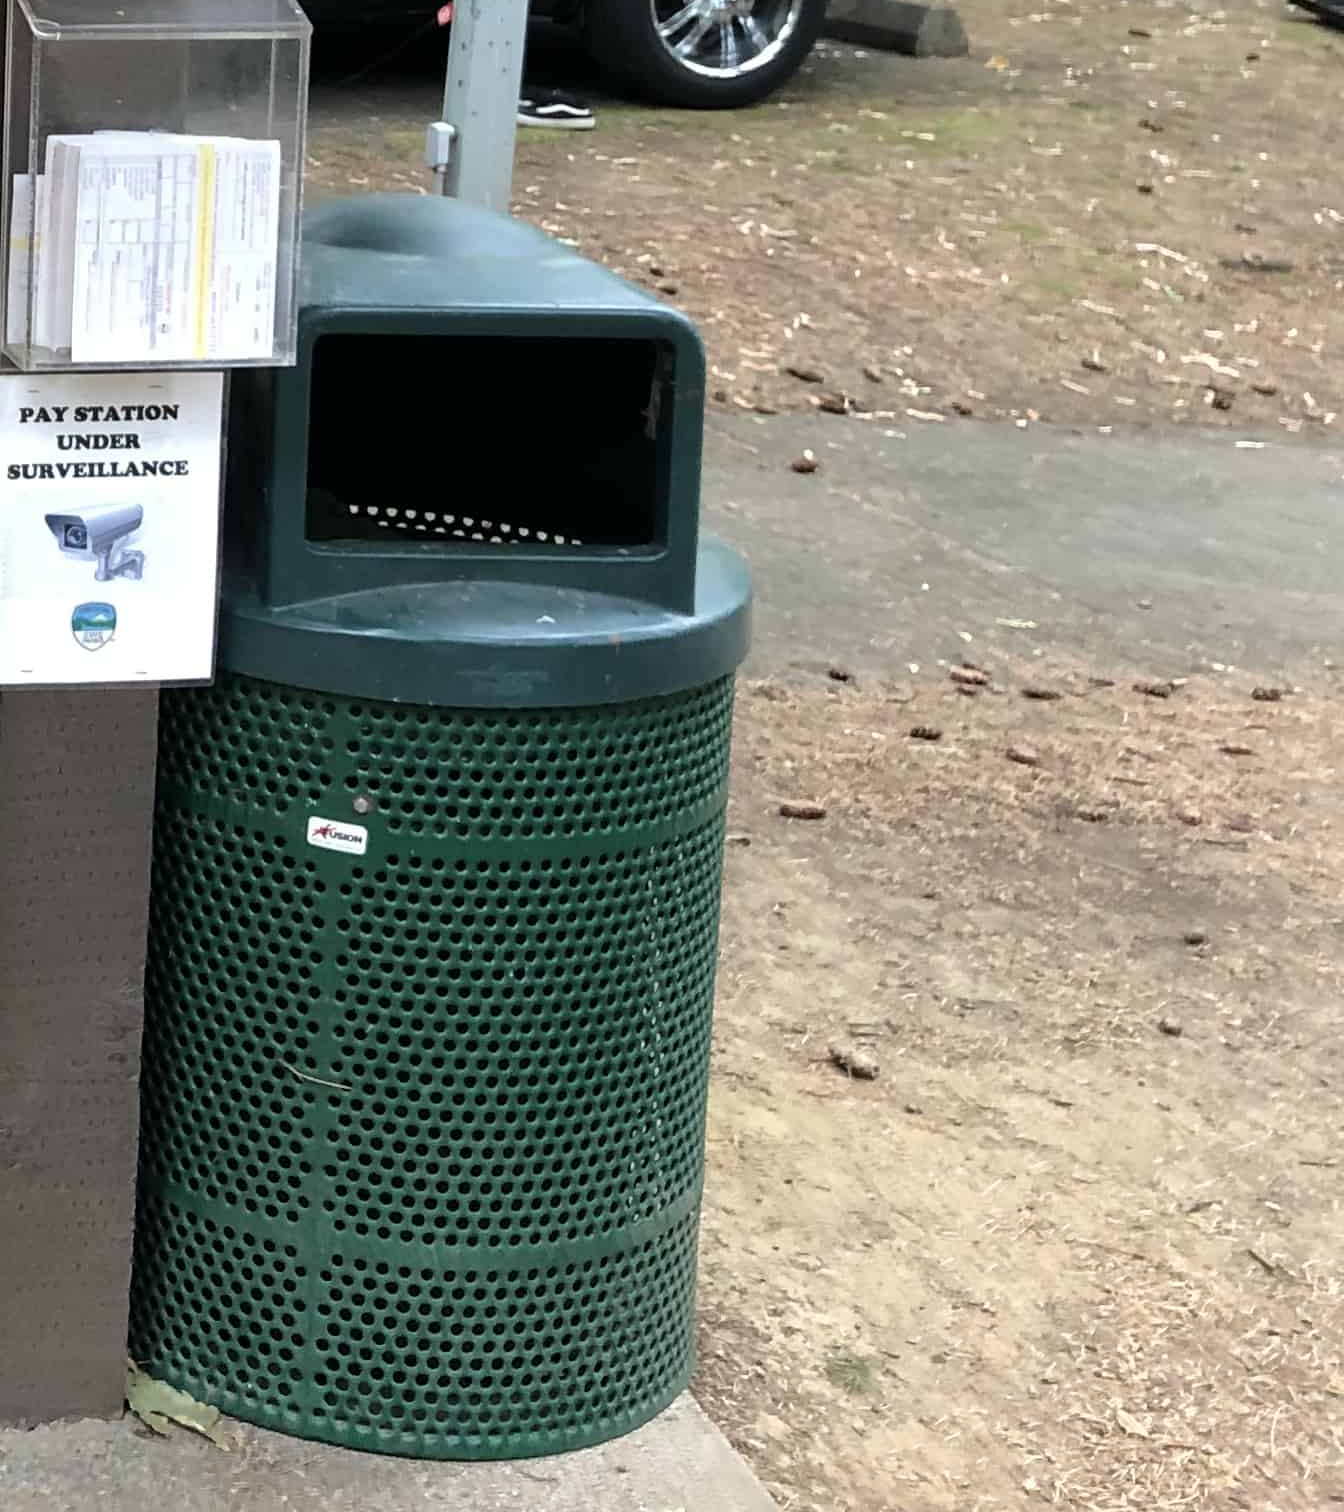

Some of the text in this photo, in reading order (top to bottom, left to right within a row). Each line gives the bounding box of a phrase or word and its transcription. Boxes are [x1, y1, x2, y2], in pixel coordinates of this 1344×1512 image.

[19, 404, 180, 423] PAY STATION
[56, 433, 141, 451] UNDER
[7, 460, 189, 480] SURVEILLANCE
